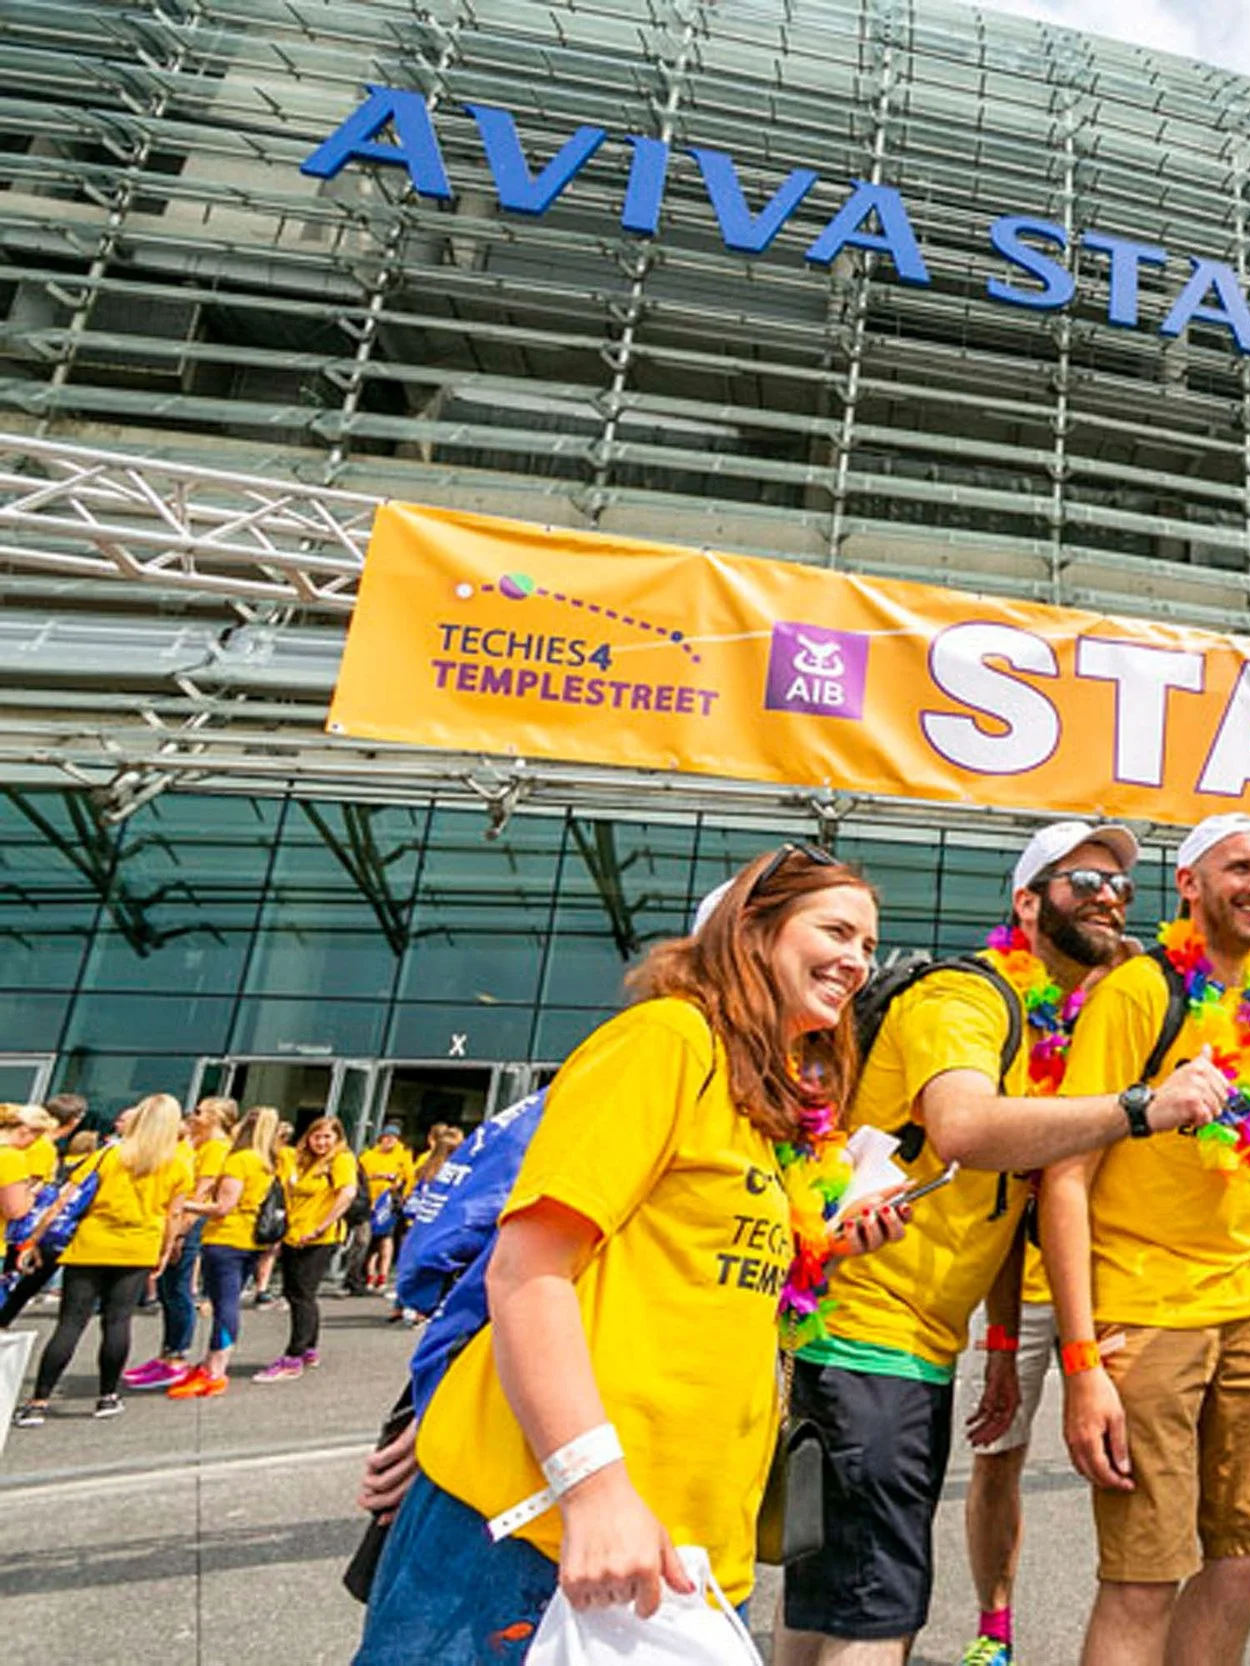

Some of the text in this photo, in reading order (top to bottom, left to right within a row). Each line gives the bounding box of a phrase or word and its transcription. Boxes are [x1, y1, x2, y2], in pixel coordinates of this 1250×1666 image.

[300, 84, 931, 286] AVIVA
[437, 623, 613, 672] TECHIES4
[431, 659, 720, 717] TEMPLESTREET
[785, 681, 845, 707] AIB
[448, 1033, 468, 1057] X
